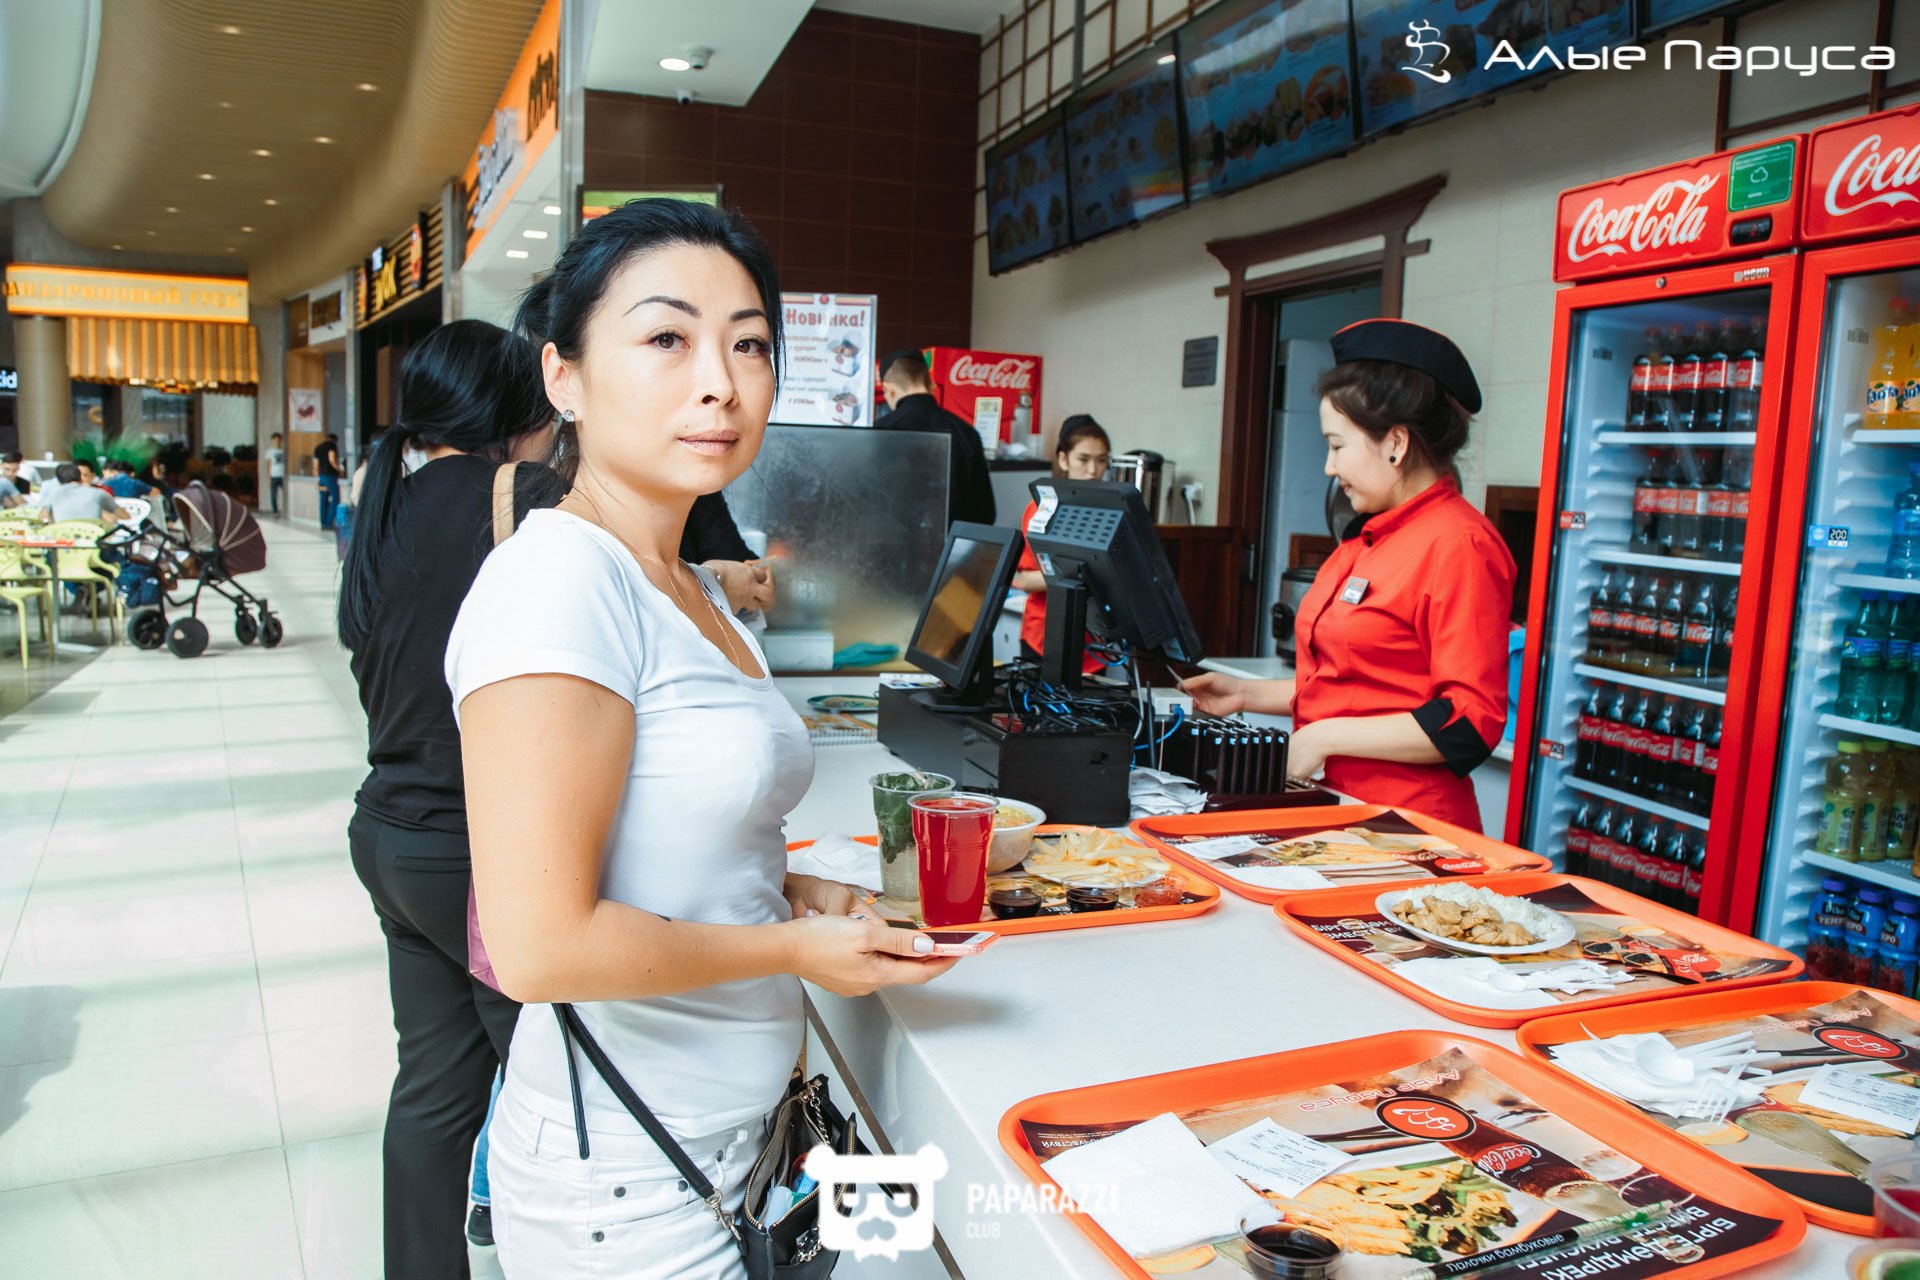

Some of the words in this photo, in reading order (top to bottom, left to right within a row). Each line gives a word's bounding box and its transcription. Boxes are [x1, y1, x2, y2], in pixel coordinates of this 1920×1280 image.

[1568, 172, 1720, 262] Coca-Cola
[949, 355, 1036, 390] Coca-Cola
[1830, 529, 1847, 540] 200
[1396, 1068, 1460, 1092] Алые
[1298, 1087, 1398, 1112] Паруса
[1477, 1143, 1542, 1179] Coca-Cola
[1674, 1216, 1738, 1249] БІРГЕ
[1446, 1253, 1497, 1273] Палочки
[1494, 1232, 1565, 1258] бамбуковые
